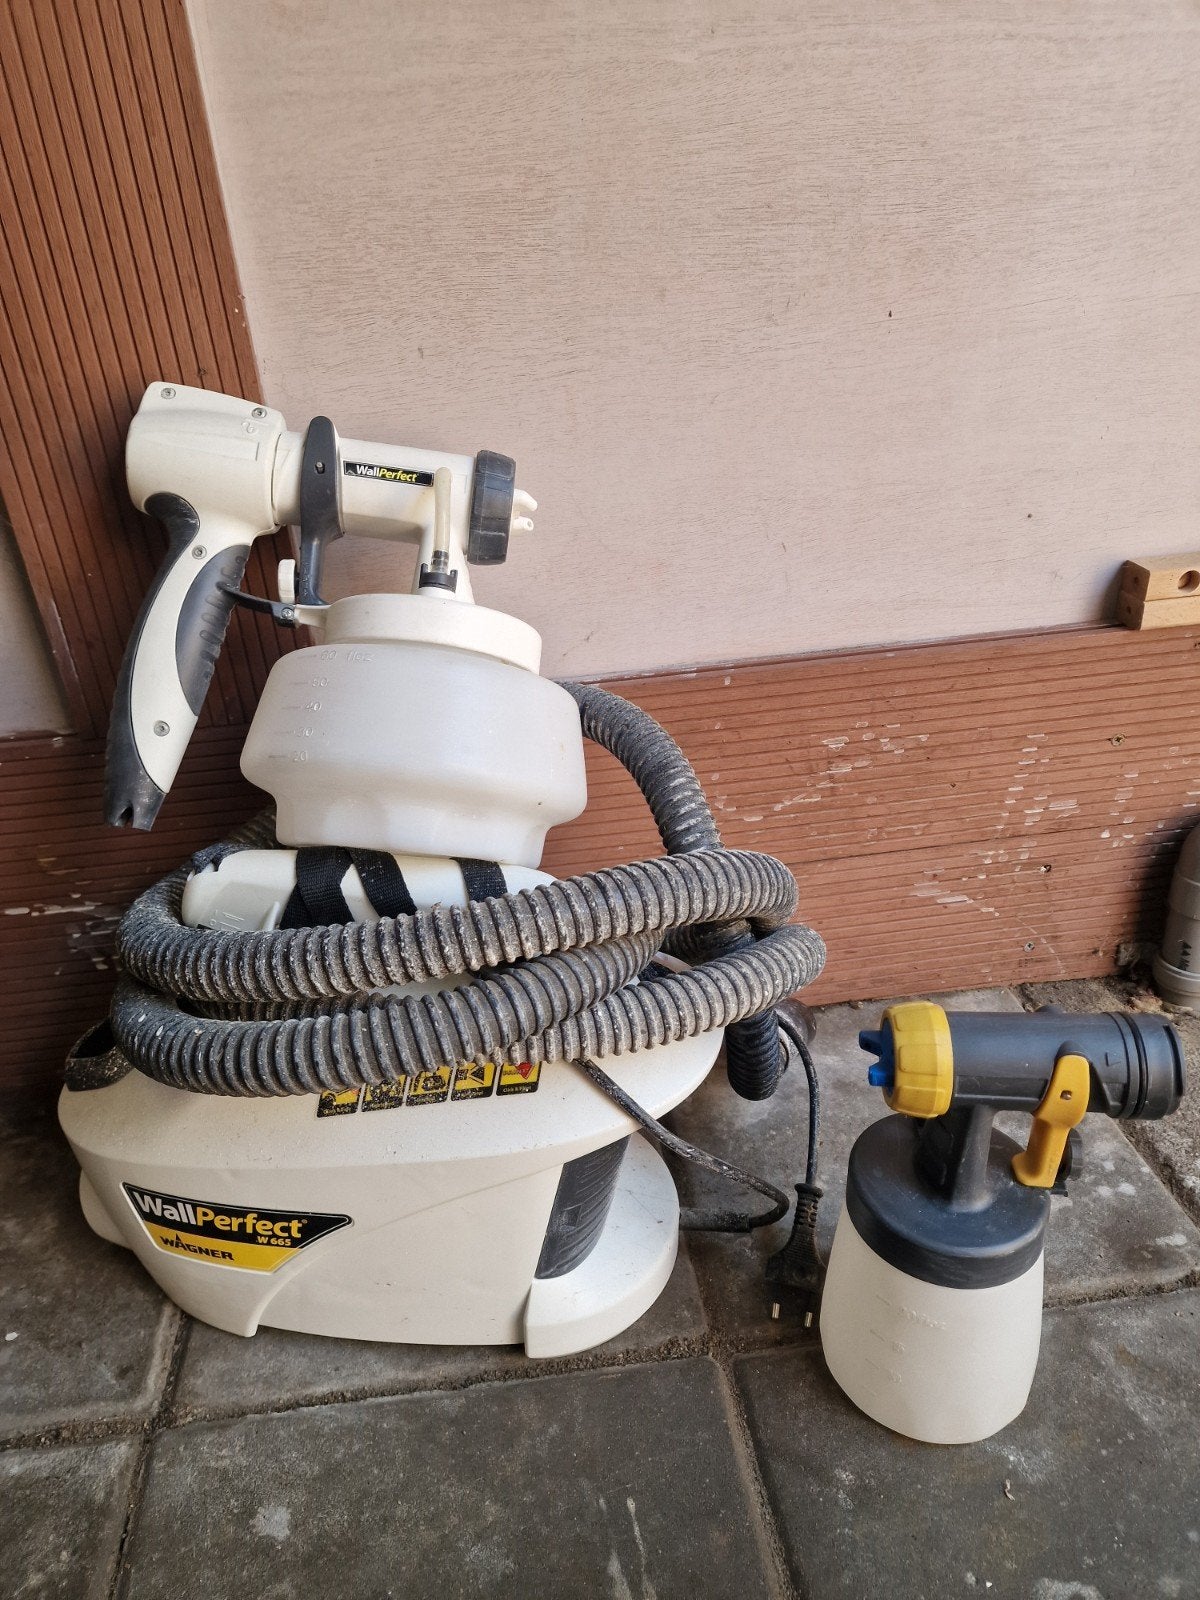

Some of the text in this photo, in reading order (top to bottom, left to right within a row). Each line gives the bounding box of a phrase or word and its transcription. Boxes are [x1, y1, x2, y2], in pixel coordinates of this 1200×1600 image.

[356, 464, 418, 482] WallPerfect
[133, 1191, 303, 1238] WallPerfect
[159, 1233, 234, 1261] WAGNER
[257, 1236, 292, 1246] W 665
